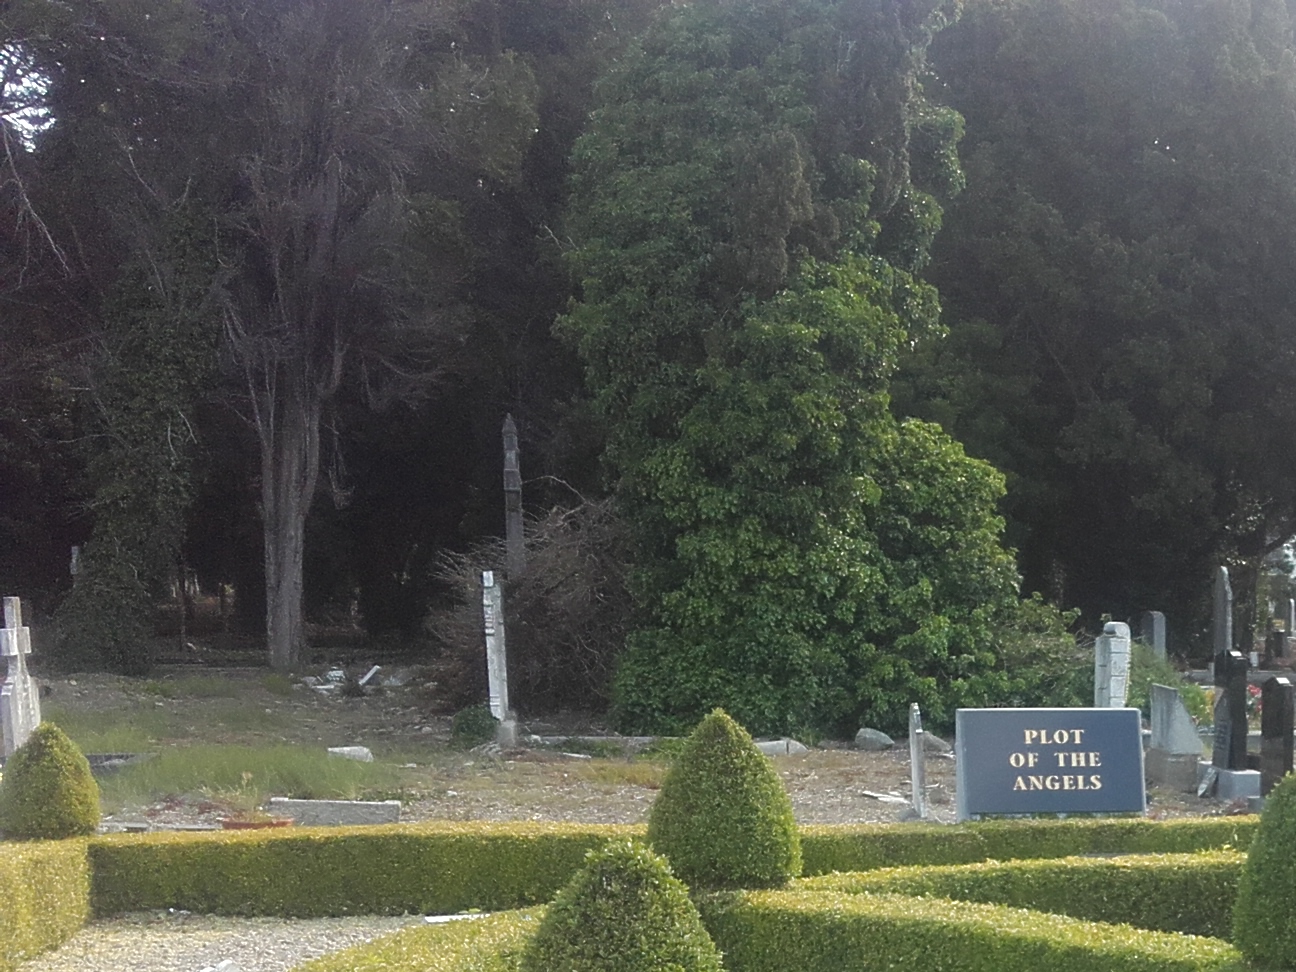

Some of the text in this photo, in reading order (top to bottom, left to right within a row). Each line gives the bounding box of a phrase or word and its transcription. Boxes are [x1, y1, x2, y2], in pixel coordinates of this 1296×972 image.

[1023, 729, 1085, 744] PLOT
[1009, 752, 1102, 768] OF THE
[1013, 774, 1102, 791] ANGELS
